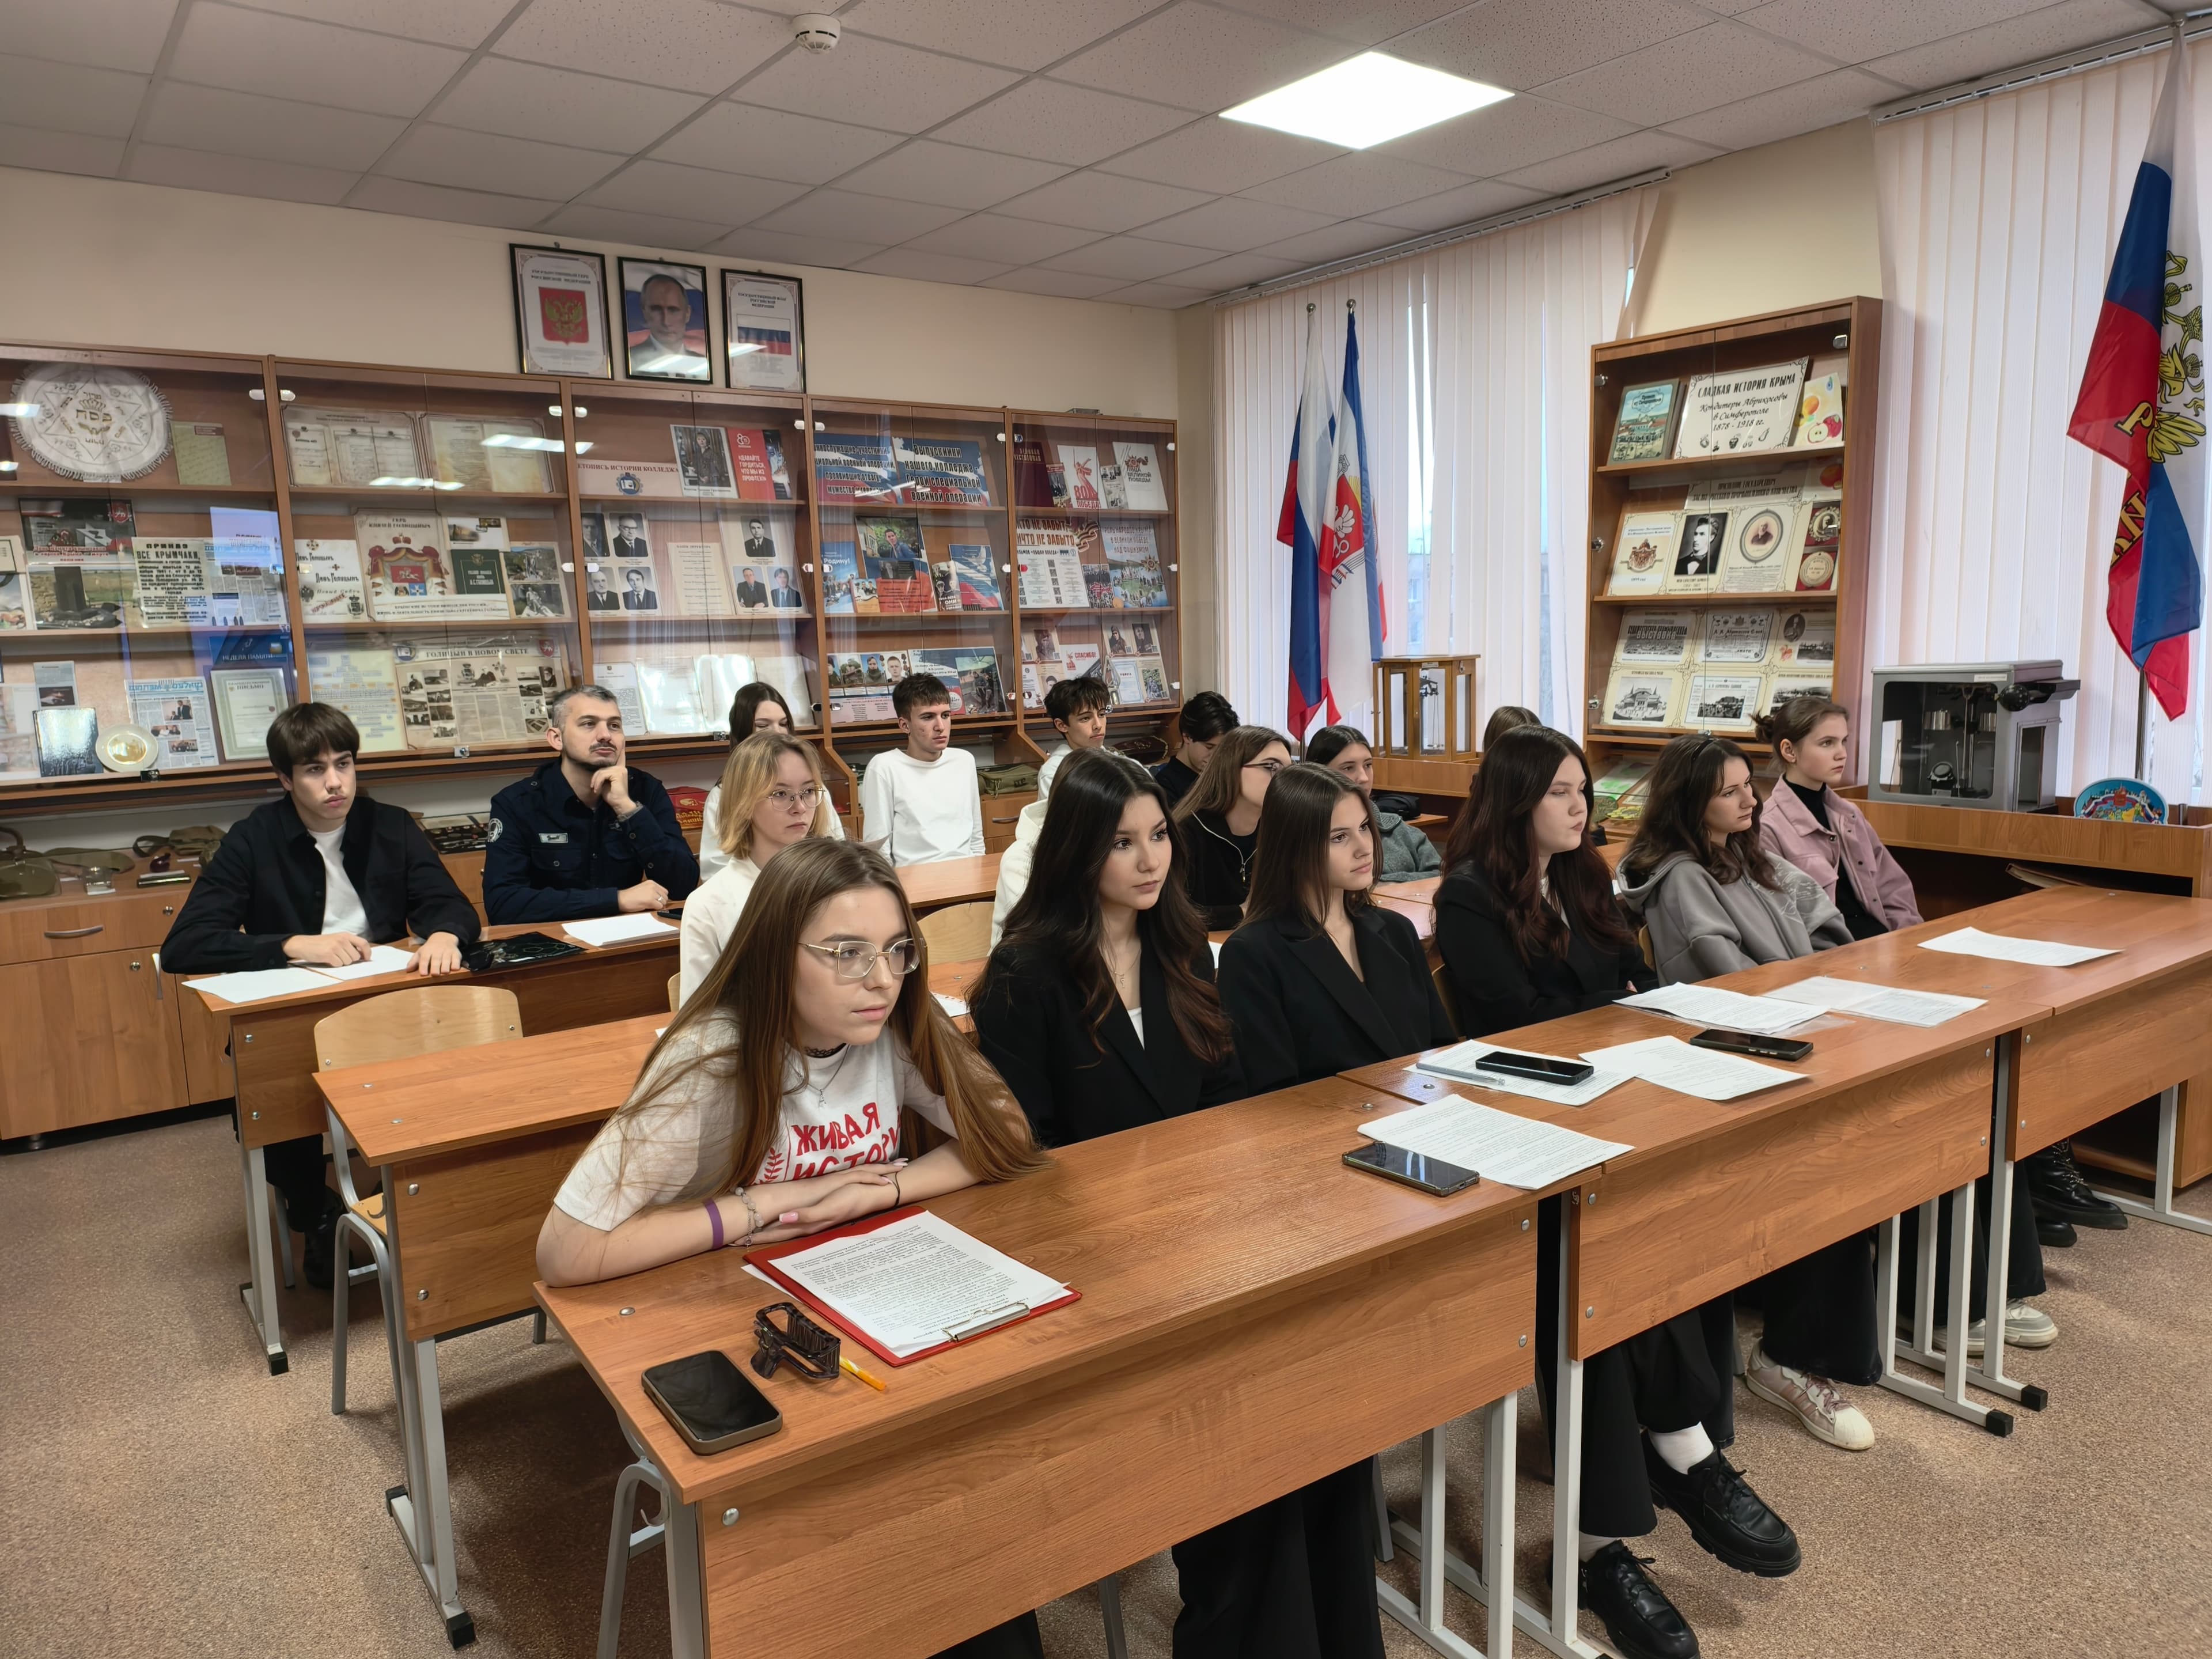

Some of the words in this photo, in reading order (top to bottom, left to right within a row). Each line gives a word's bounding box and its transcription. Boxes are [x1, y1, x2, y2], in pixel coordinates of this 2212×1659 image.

[1698, 384, 1730, 397] СЛАДКАЯ
[1734, 379, 1767, 393] ИСТОРИЯ
[1770, 373, 1796, 388] КРЫМА
[1699, 401, 1741, 412] Кондитеры
[1742, 392, 1788, 407] Абрикосовы
[1719, 407, 1769, 421] Симферополе
[1713, 422, 1730, 431] 1878
[1737, 419, 1755, 428] 1918
[914, 444, 962, 457] Выпускники
[905, 461, 933, 471] нашего
[934, 463, 974, 474] колледжа
[906, 474, 929, 486] Герои
[930, 476, 981, 488] специальной
[911, 491, 944, 502] военной
[945, 493, 982, 504] операции
[1031, 518, 1041, 530] НЕ
[1036, 534, 1046, 545] НЕ
[1047, 534, 1075, 546] ЗАБЫТО
[137, 551, 150, 559] ВСЕ
[156, 551, 200, 560] КРЫМЧАКИ,
[791, 1102, 881, 1156] ЖИВАЯ
